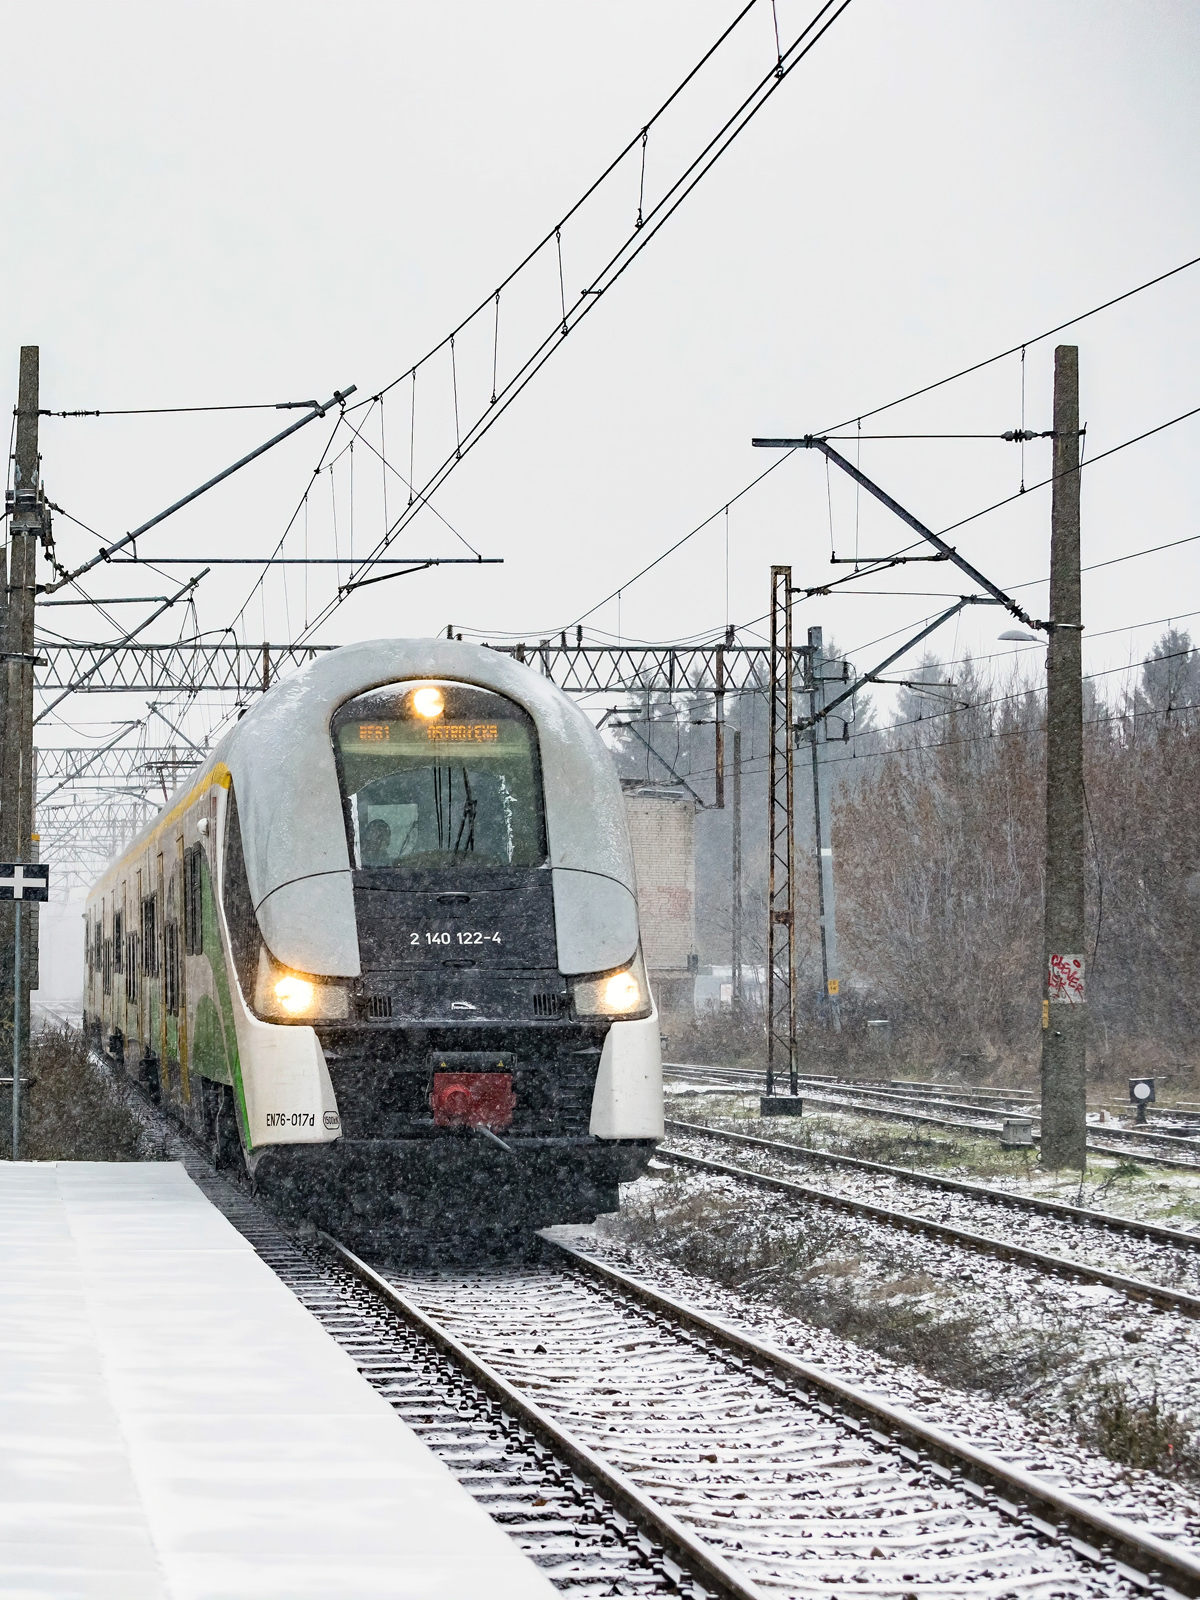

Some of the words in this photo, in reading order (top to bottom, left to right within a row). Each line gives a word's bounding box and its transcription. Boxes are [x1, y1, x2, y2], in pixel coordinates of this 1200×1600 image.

[409, 932, 420, 945] 2
[425, 932, 451, 945] 140
[456, 931, 502, 945] 122-4
[266, 1113, 315, 1127] EN76-017d
